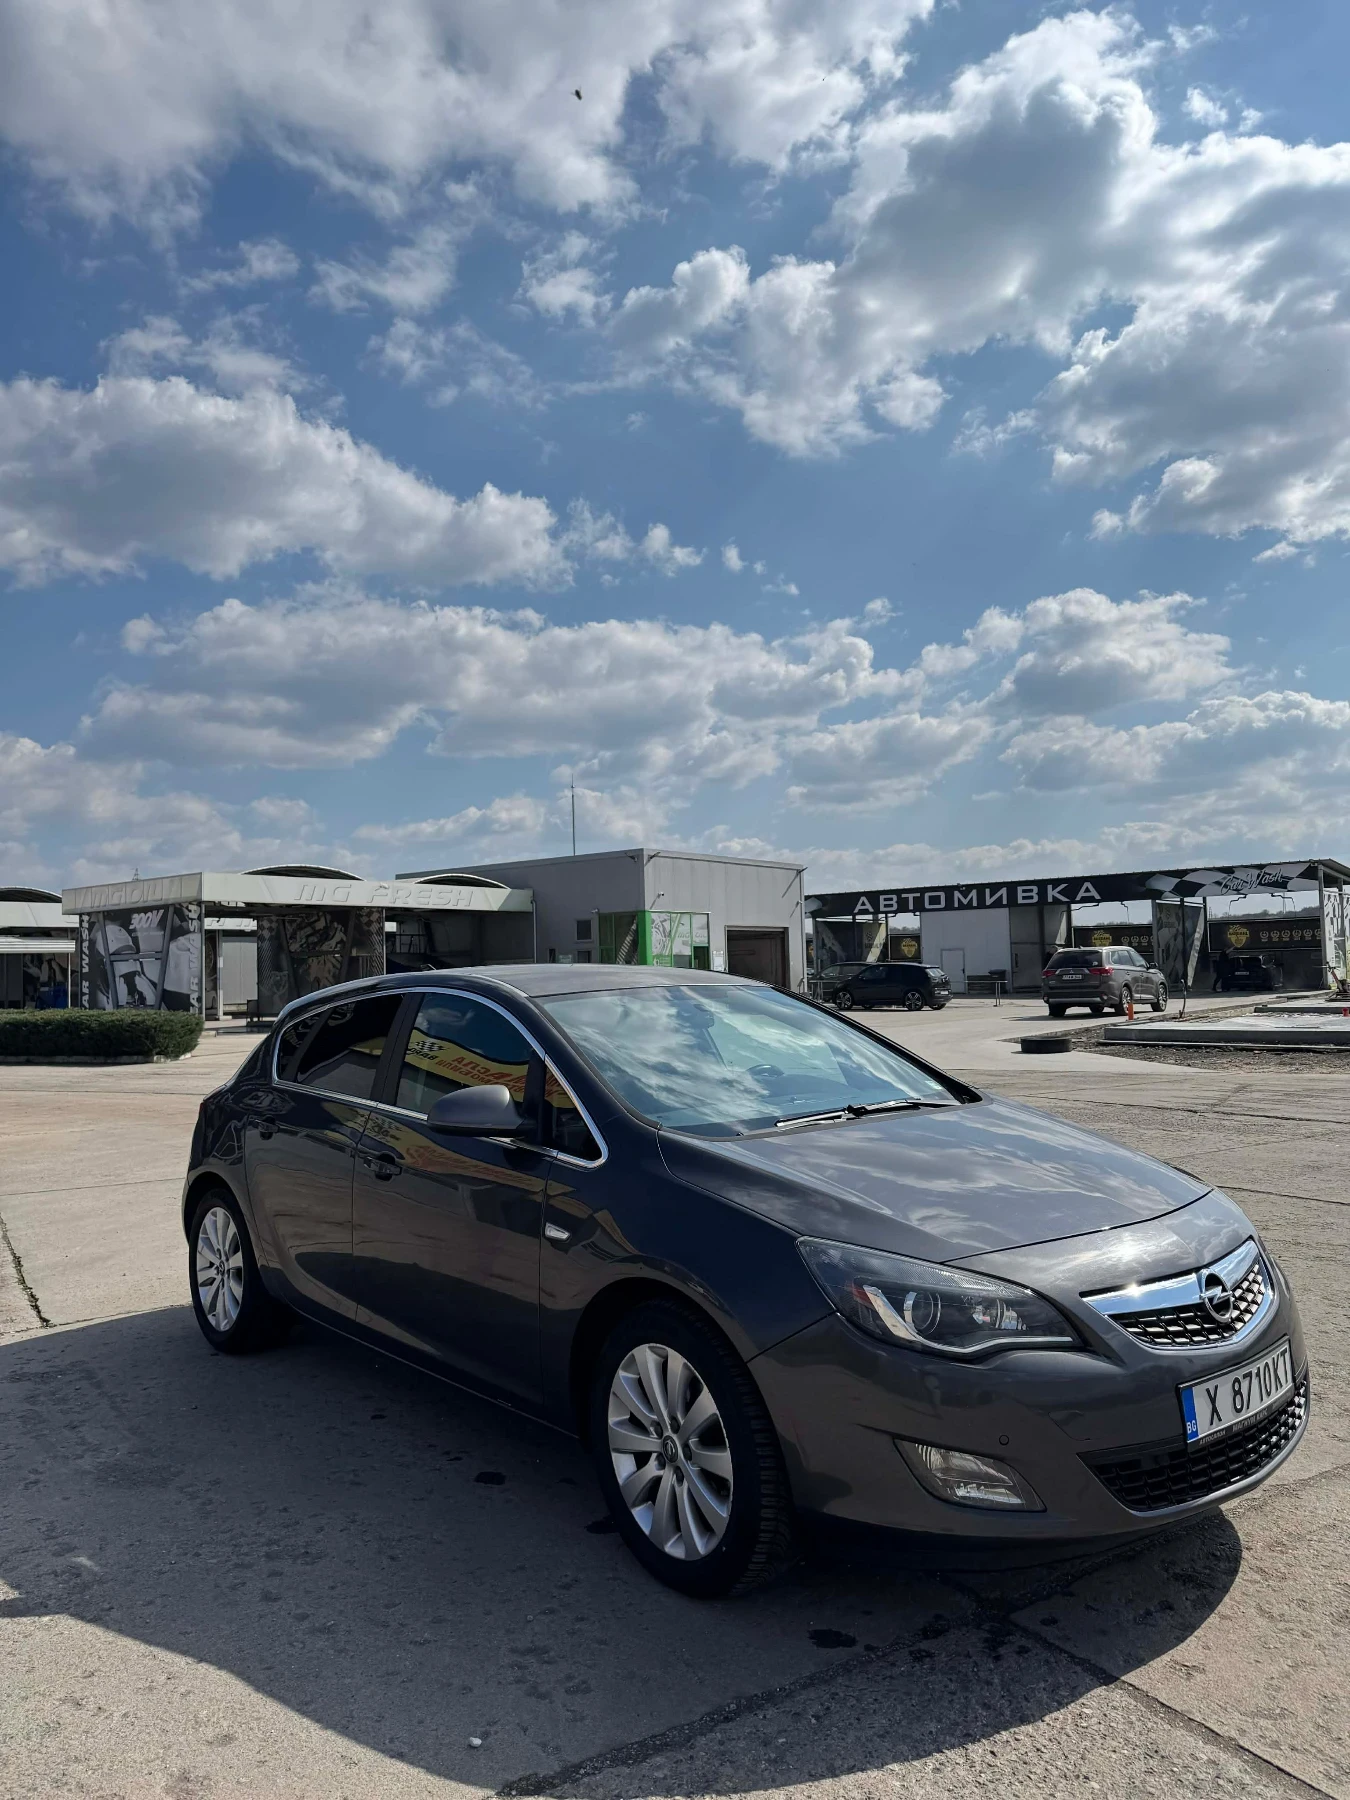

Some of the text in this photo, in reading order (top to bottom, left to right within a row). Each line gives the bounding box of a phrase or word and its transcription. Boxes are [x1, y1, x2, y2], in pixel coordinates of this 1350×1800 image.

[1220, 868, 1283, 895] Car Wash
[294, 884, 474, 907] MG FRESH
[853, 881, 1102, 914] АВТОМИВКА
[129, 909, 165, 930] 300V
[81, 914, 90, 1010] AR WASH
[1205, 1347, 1288, 1426] X 8710KT
[1186, 1420, 1197, 1434] BG
